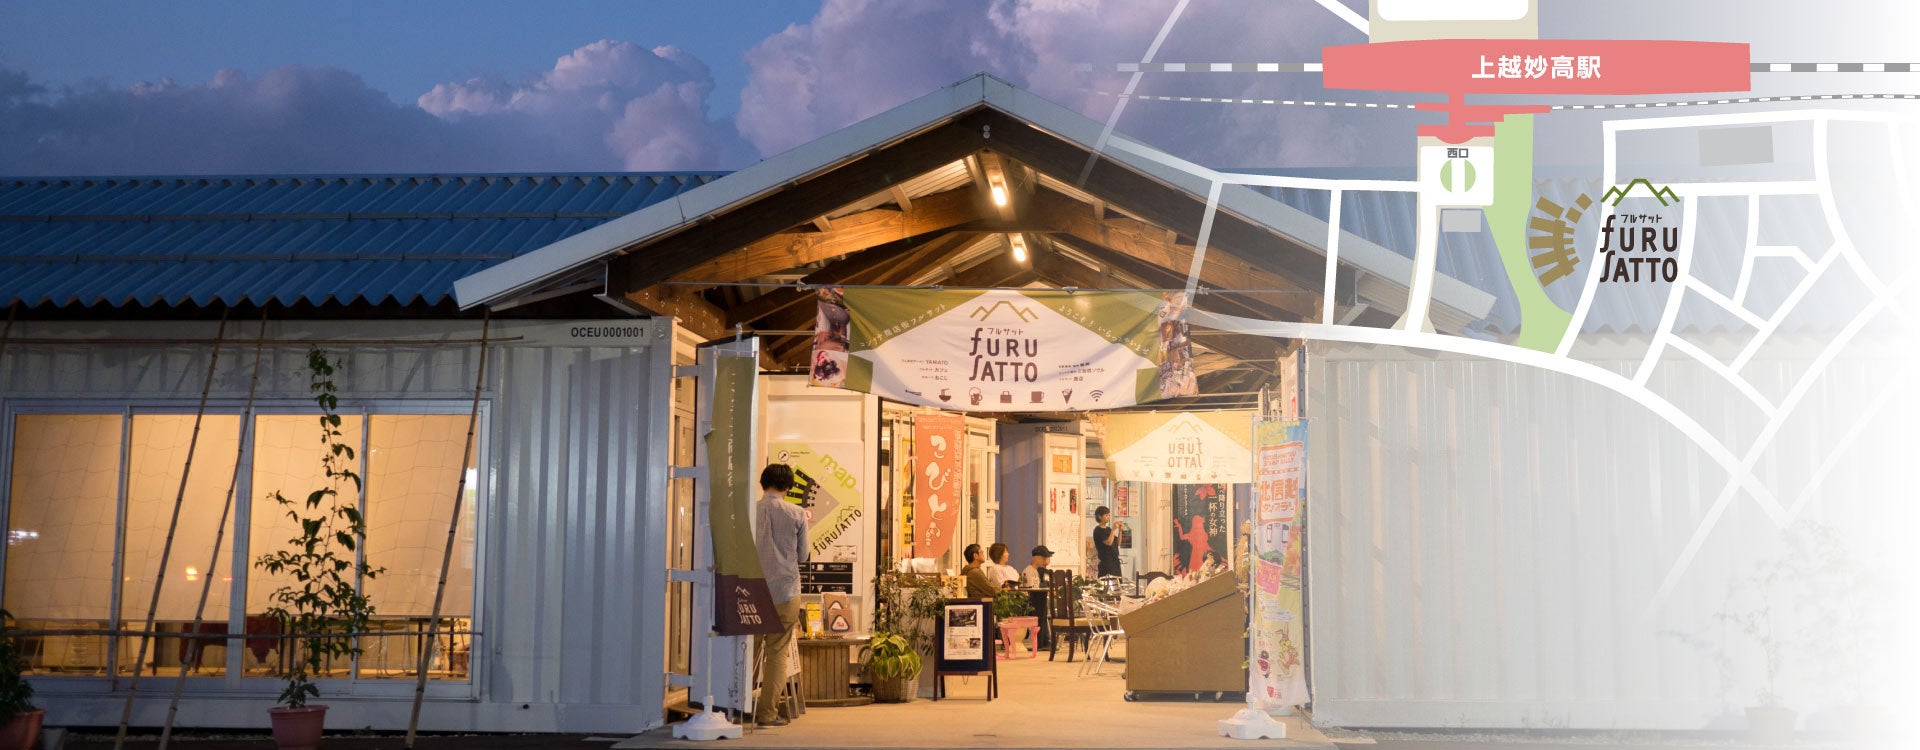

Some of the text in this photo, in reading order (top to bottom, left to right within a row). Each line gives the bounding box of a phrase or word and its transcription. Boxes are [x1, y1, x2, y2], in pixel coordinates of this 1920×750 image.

[571, 327, 644, 337] OCEU 0001001
[987, 327, 1024, 335] フルサット
[820, 454, 857, 490] map
[1208, 496, 1218, 536] 一杯の女神
